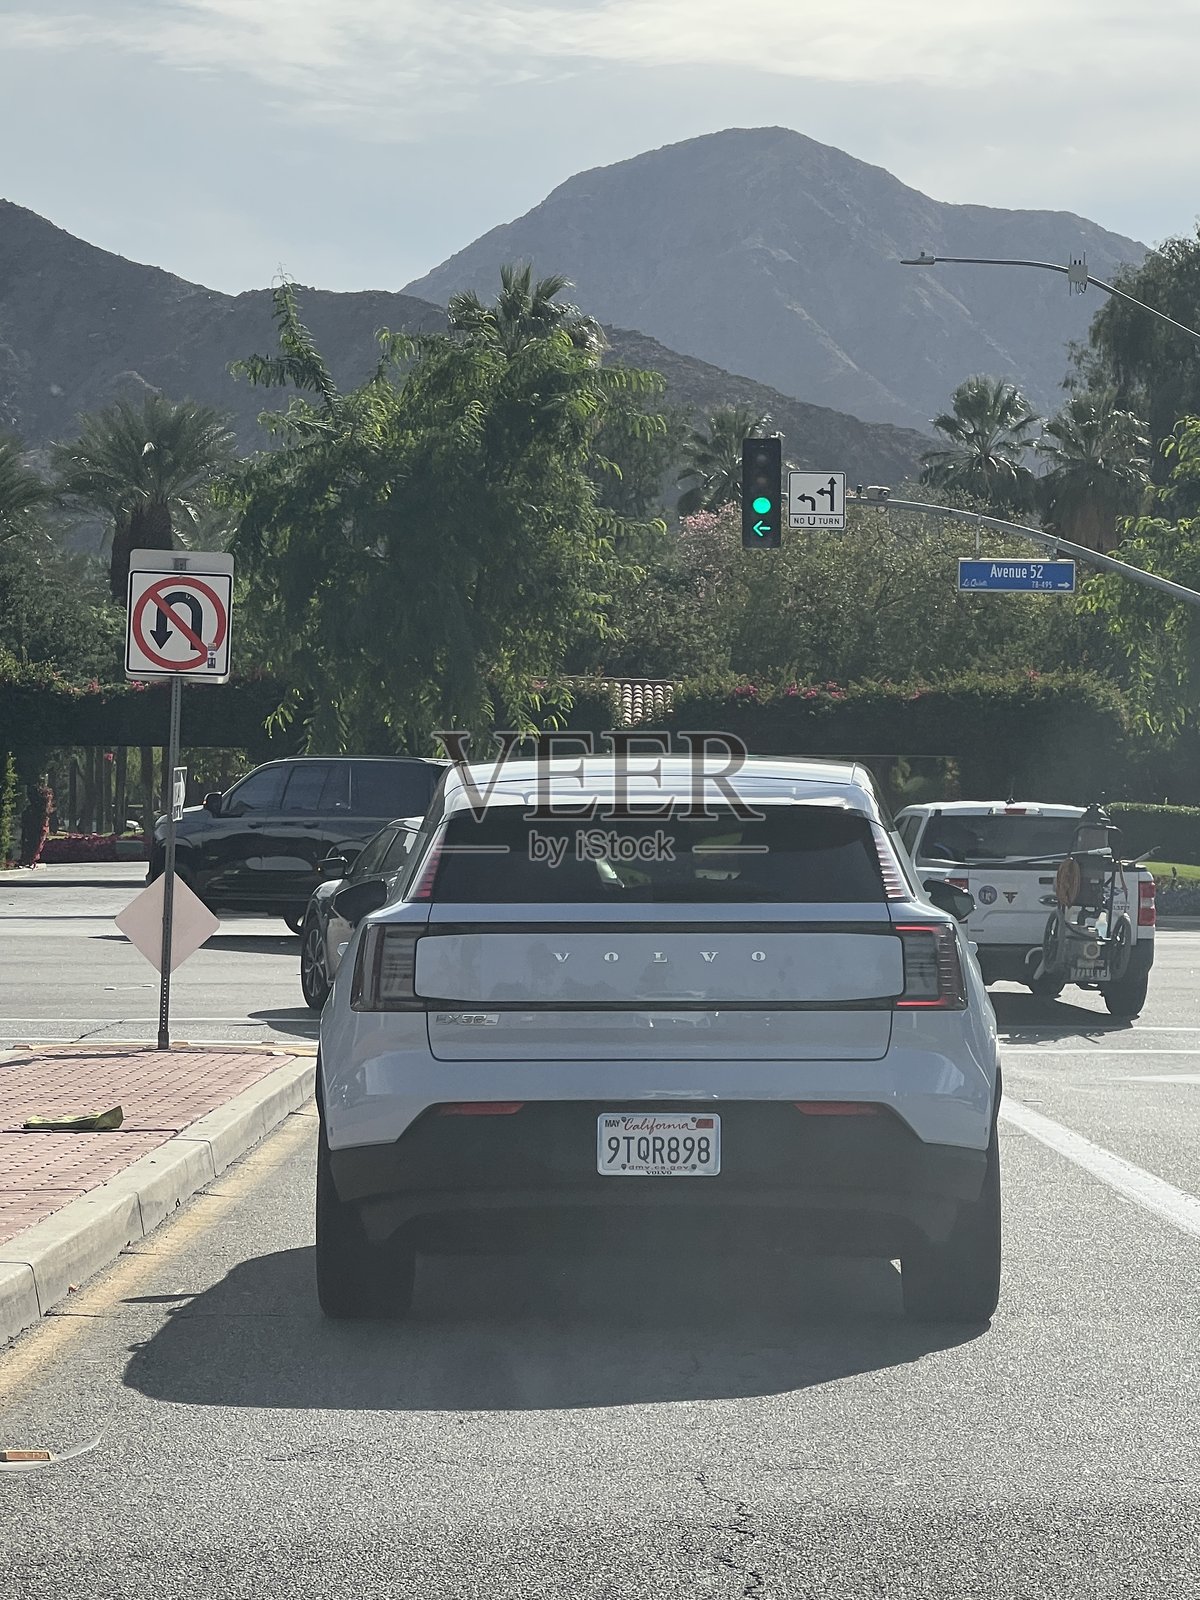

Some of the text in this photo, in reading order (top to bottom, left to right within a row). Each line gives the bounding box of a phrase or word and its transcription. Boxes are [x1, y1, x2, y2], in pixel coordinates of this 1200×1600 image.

[793, 516, 840, 526] NO U TURN
[990, 563, 1044, 579] Avenue 52
[553, 951, 767, 964] VOLVO
[605, 1119, 620, 1128] MAY
[624, 1117, 697, 1135] California
[607, 1136, 710, 1164] 9TQR898
